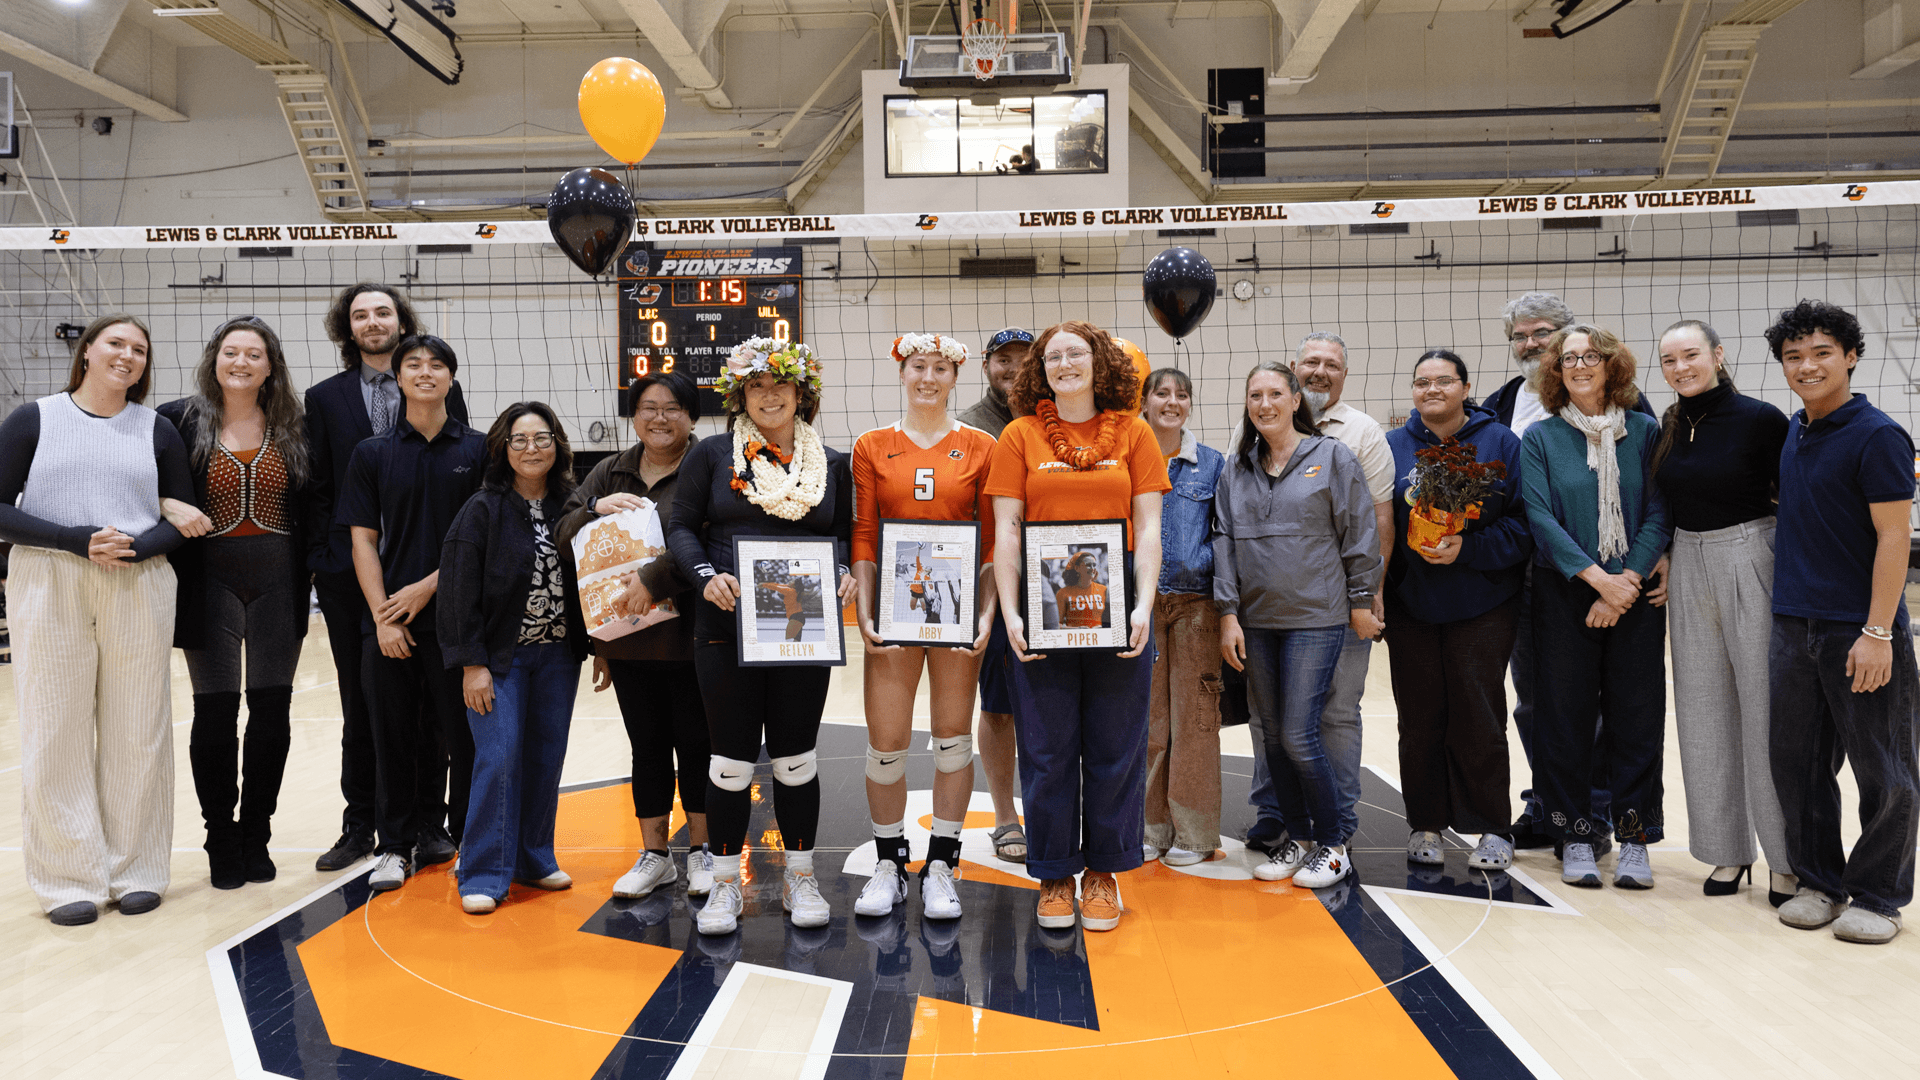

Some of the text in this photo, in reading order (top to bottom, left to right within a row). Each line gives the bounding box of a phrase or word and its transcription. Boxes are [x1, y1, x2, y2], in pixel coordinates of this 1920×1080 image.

[1478, 189, 1756, 214] LEWIS & CLARK VOLLEYBALL
[1019, 205, 1288, 227] LEWIS & CLARK VOLLEYBALL
[145, 225, 398, 242] LEWIS & CLARK VOLLEYBALL
[637, 216, 835, 235] & CLARK VOLLEYBALL
[656, 257, 792, 276] PIONEERS
[700, 279, 743, 303] 1:15
[638, 308, 659, 320] L&C
[695, 313, 722, 322] PERIOD
[757, 306, 780, 318] WILL
[651, 321, 667, 346] 0
[658, 347, 678, 356] T.O.L.
[685, 346, 712, 355] PLAYER
[913, 467, 936, 502] 5
[918, 626, 943, 640] ABBY
[1067, 632, 1099, 647] PIPER
[779, 643, 815, 657] REILYN
